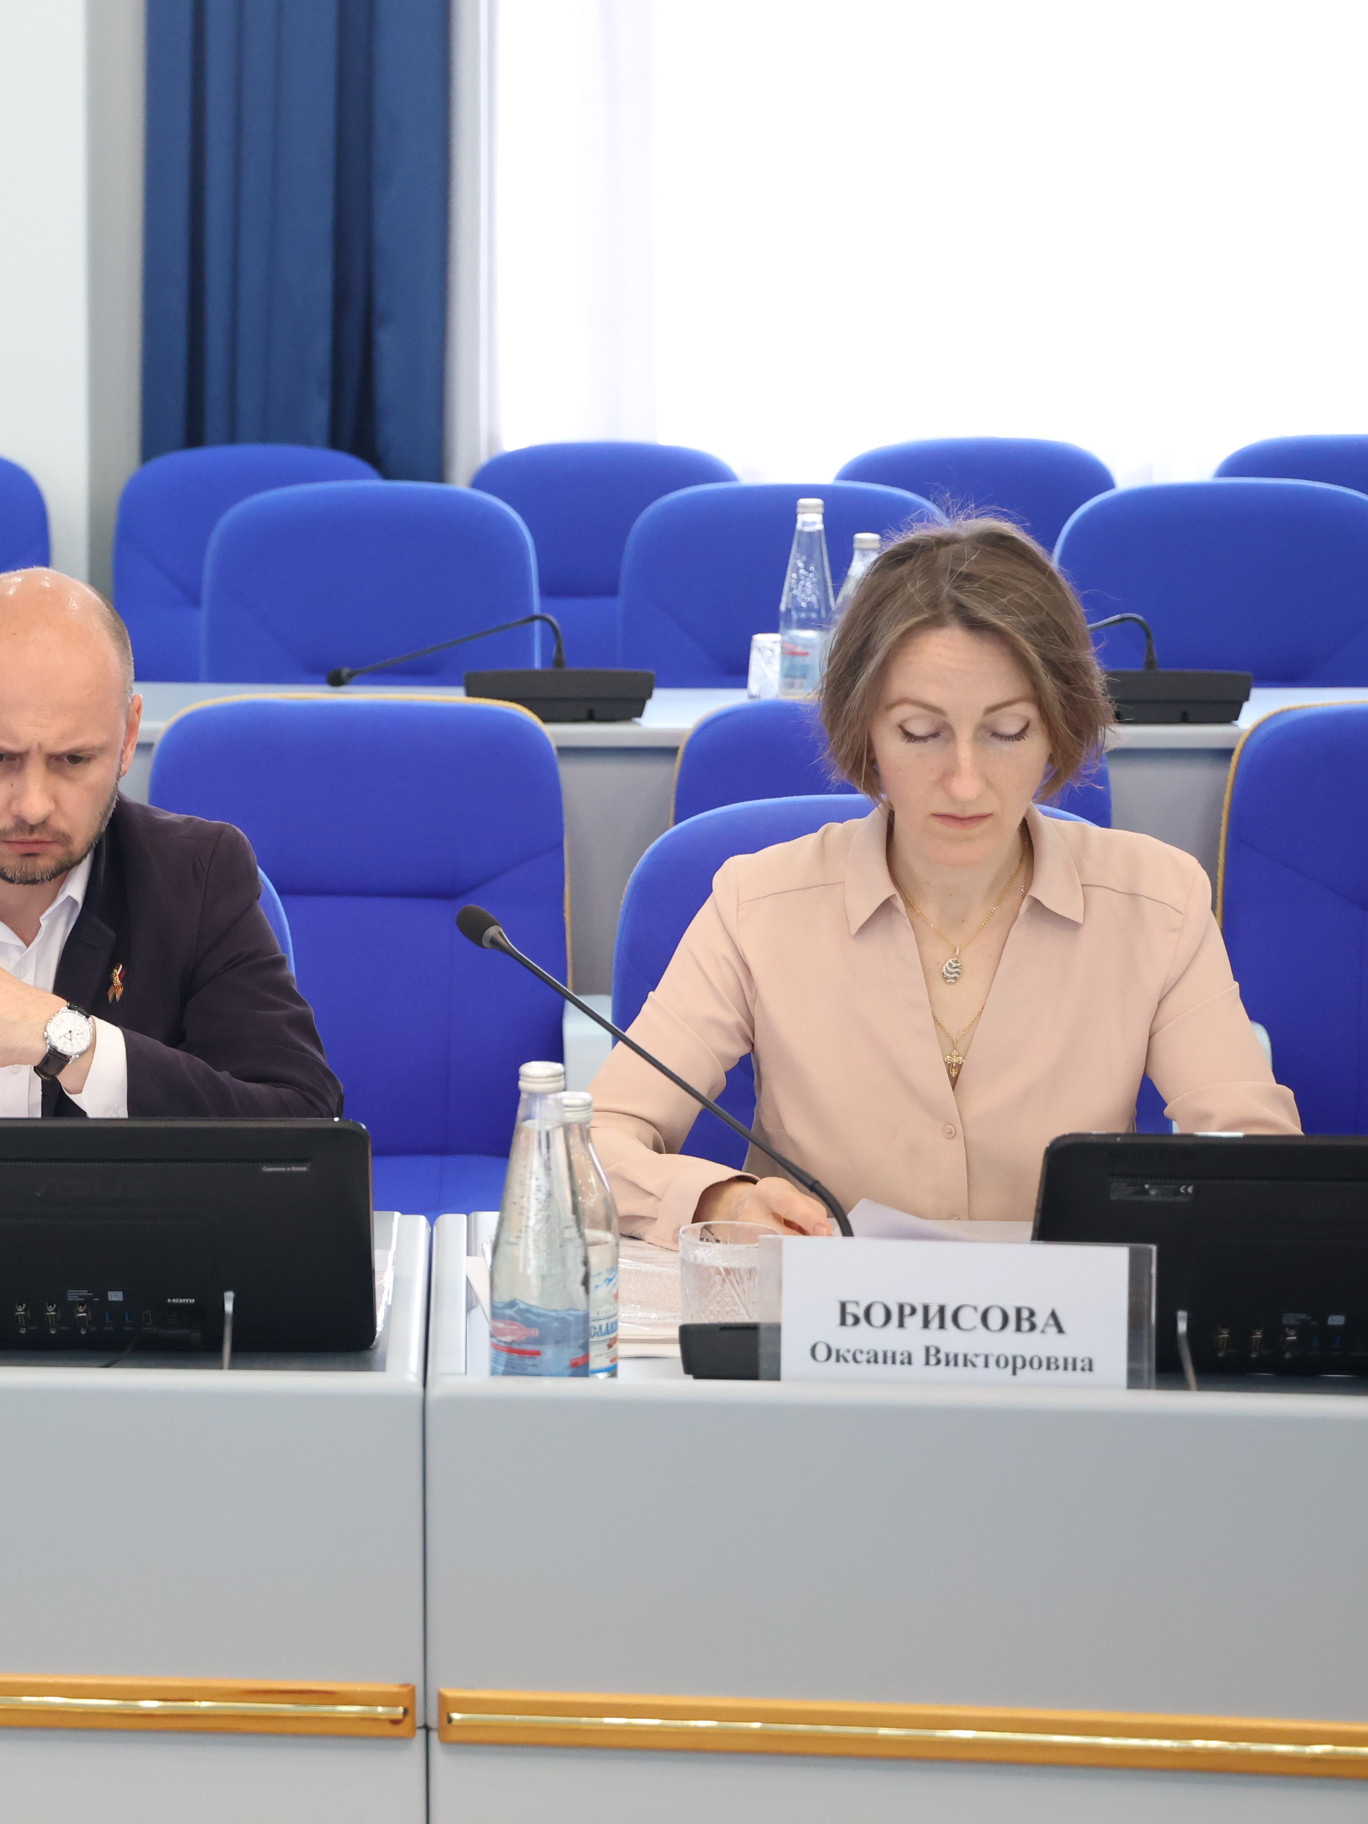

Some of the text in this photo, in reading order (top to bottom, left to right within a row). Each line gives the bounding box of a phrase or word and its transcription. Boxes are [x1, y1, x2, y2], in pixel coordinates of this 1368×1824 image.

[838, 1301, 1065, 1335] БОРИСОВА
[809, 1341, 1095, 1376] Оксана Викторовна
